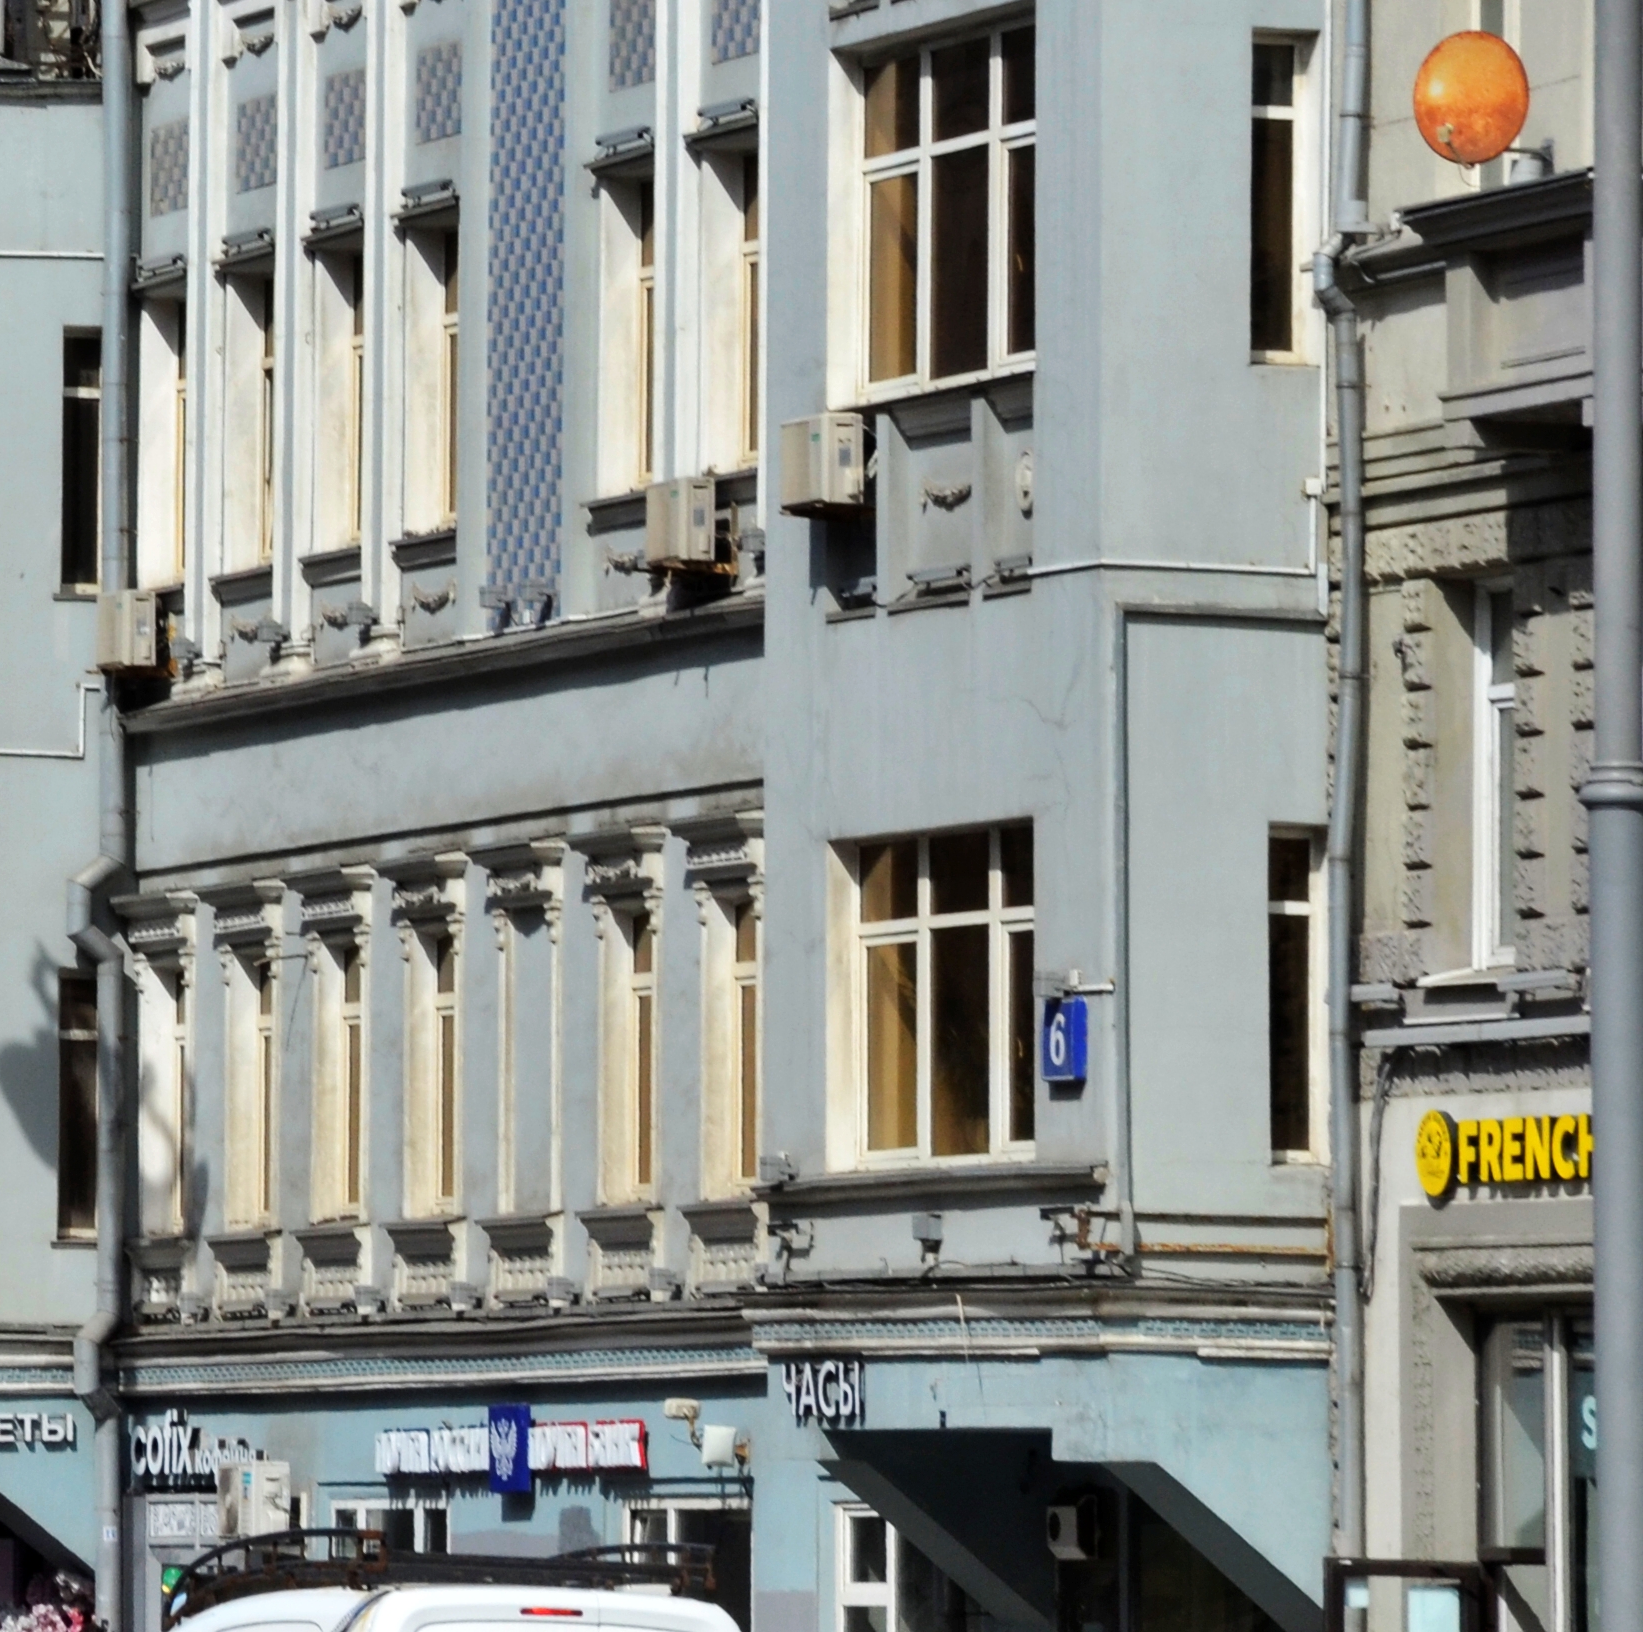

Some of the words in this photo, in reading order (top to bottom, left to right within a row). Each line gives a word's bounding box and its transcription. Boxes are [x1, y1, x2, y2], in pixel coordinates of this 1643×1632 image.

[1050, 1012, 1066, 1066] 6
[1457, 1113, 1595, 1184] FRENCH
[782, 1360, 860, 1418] ЧАСЫ
